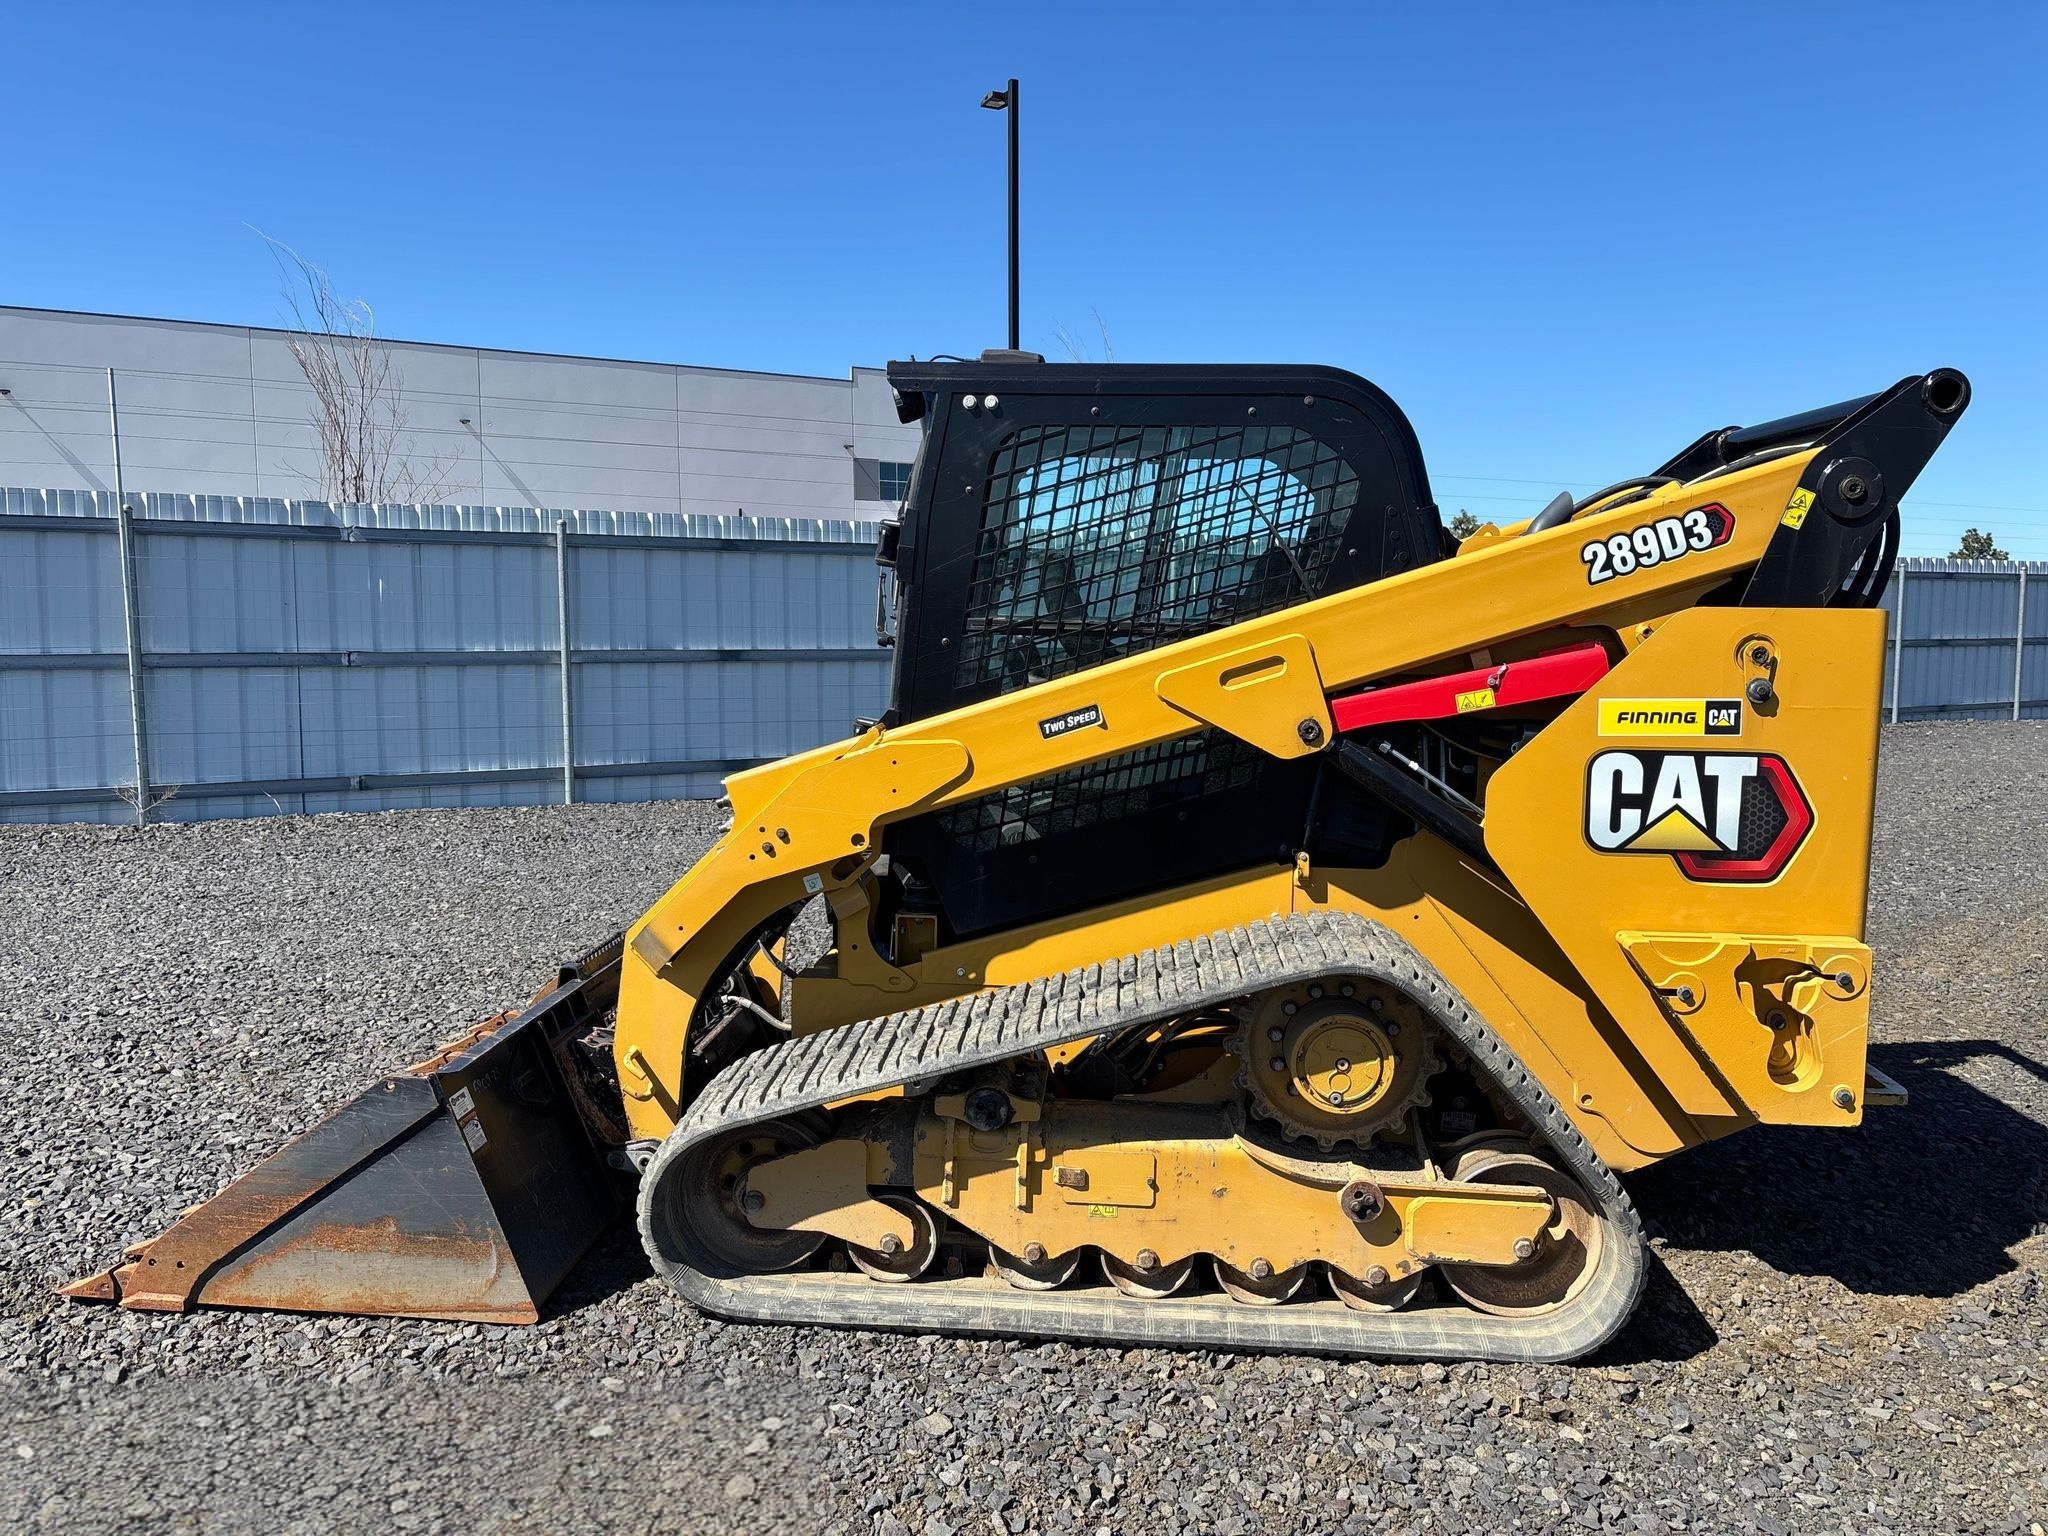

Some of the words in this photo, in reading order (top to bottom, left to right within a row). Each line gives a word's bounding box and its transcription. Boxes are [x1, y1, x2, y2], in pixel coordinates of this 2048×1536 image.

[1583, 510, 1713, 583] 289D3
[1043, 720, 1065, 735] TWO
[1067, 710, 1097, 728] SPEED
[1617, 711, 1698, 724] FINNING
[1708, 708, 1738, 726] CAT
[1589, 752, 1758, 851] CAT
